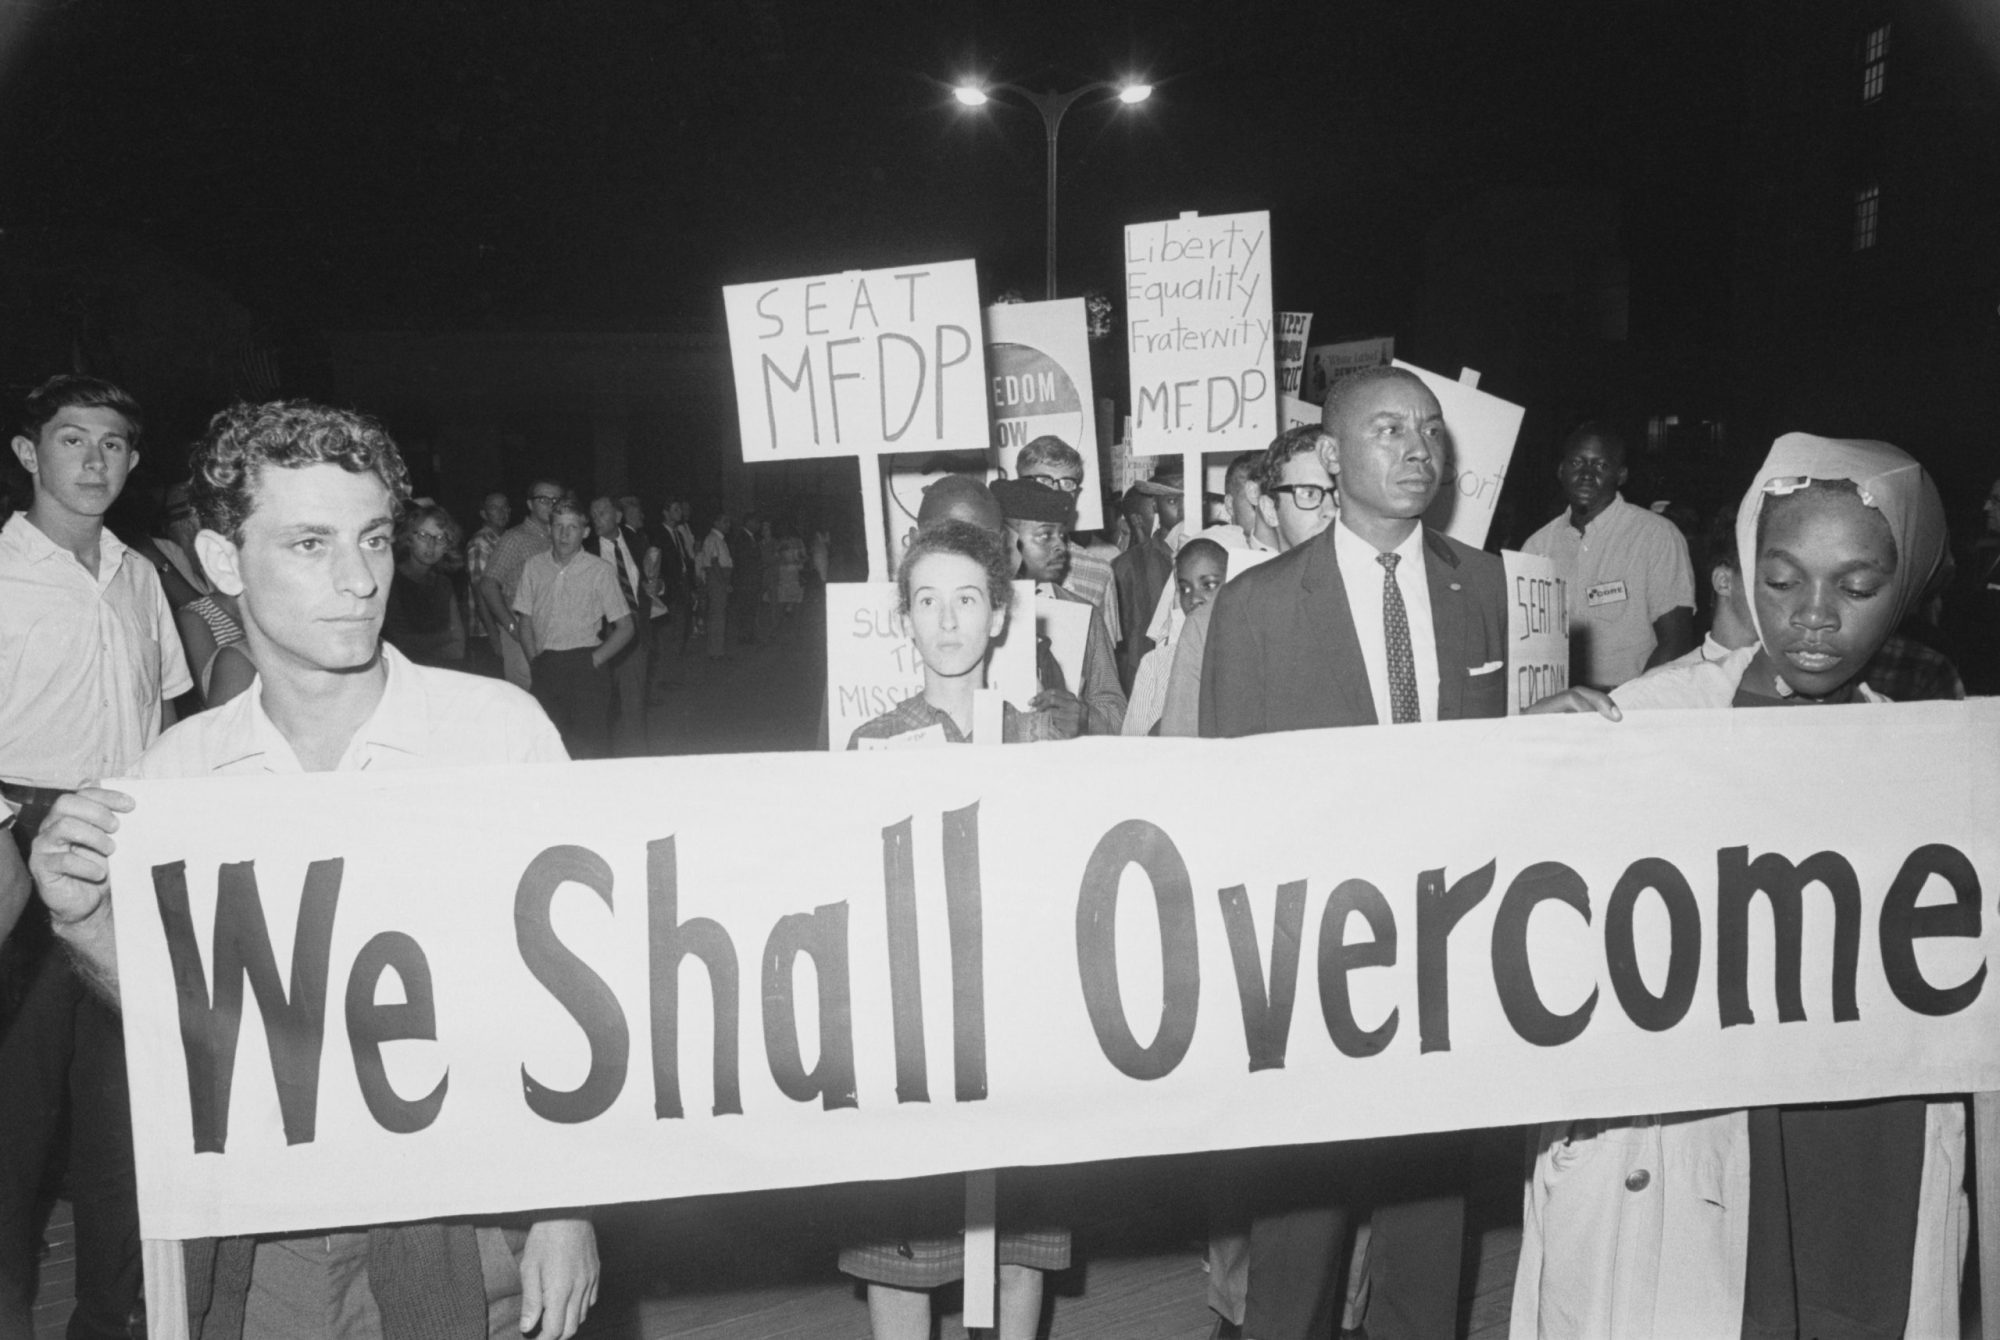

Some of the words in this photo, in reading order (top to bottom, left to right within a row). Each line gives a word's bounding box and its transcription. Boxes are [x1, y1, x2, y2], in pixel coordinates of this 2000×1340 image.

[1127, 220, 1264, 281] Liberty
[756, 272, 930, 339] SEAT
[1127, 264, 1260, 317] Equality
[761, 325, 971, 449] MFDP
[852, 607, 898, 639] SU
[151, 857, 449, 1155] We
[514, 796, 988, 1125] Shall
[1076, 818, 1988, 1081] Overcome
